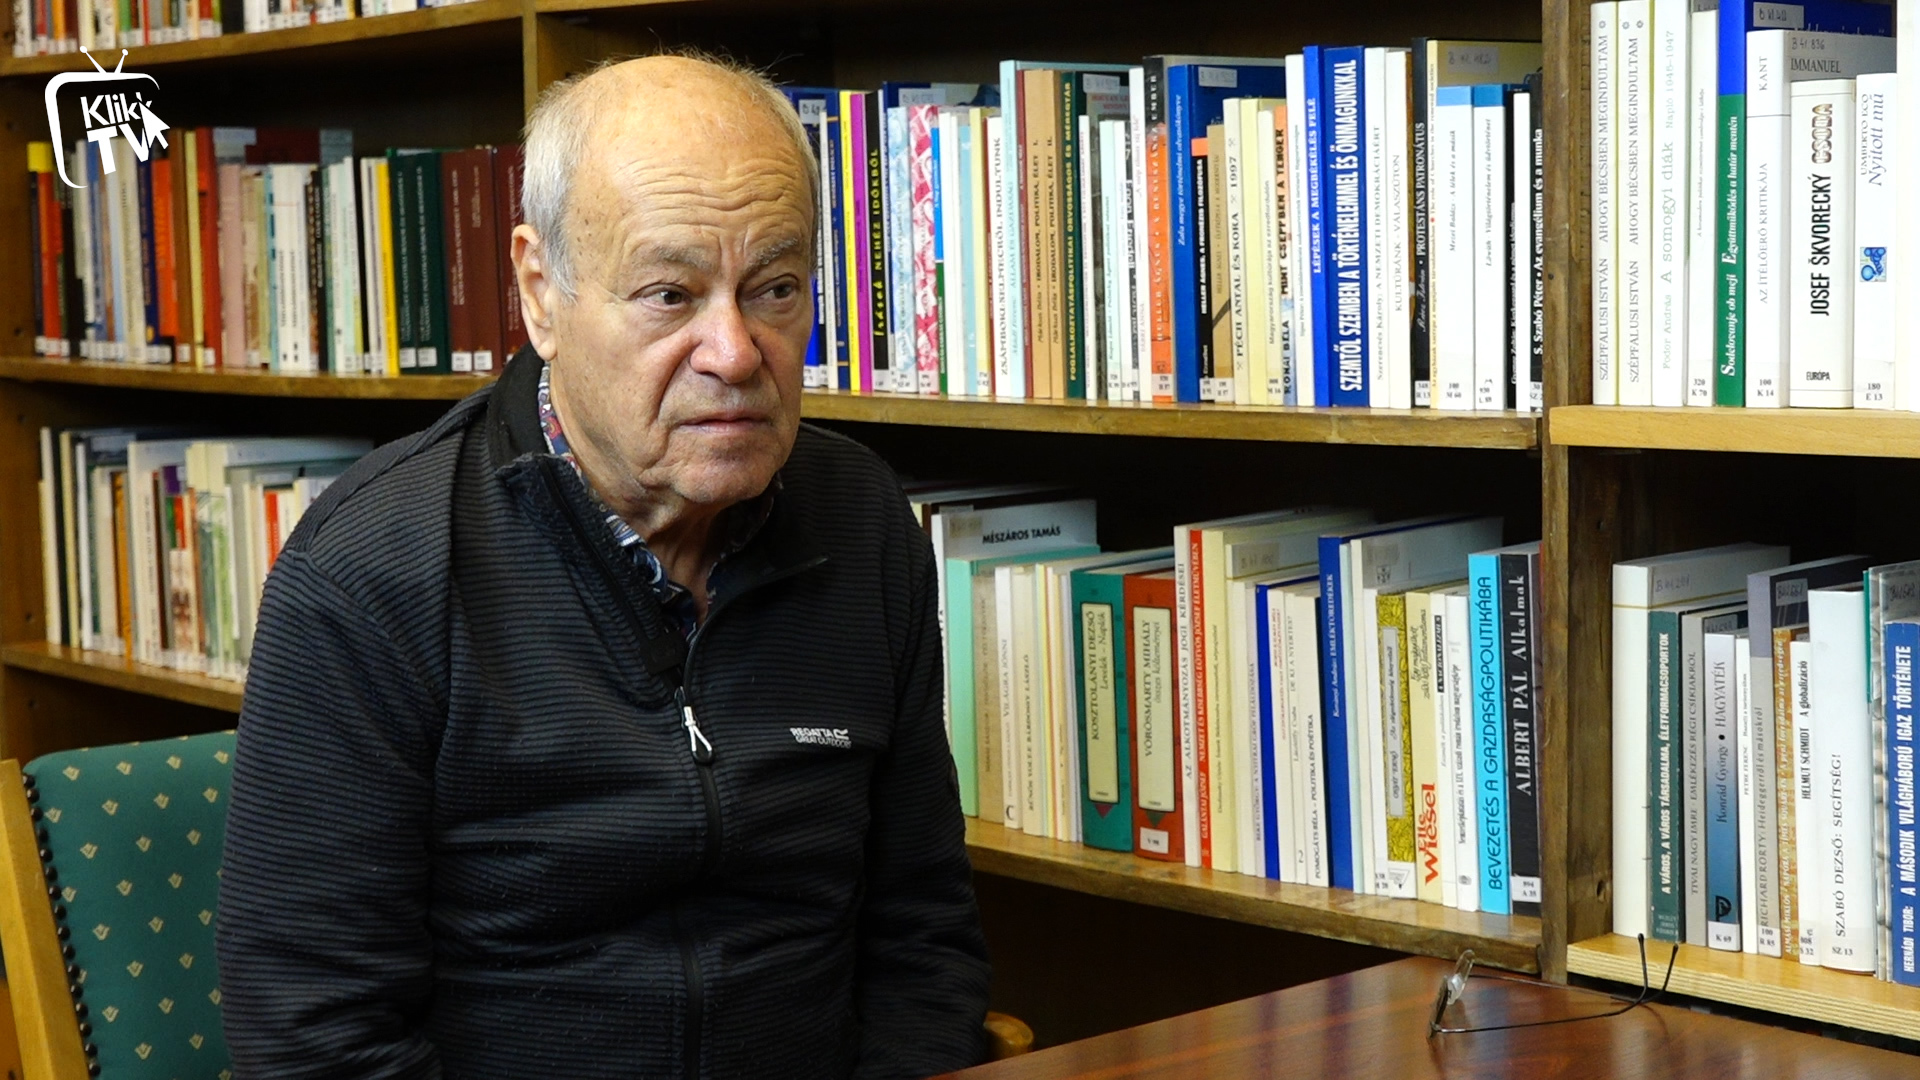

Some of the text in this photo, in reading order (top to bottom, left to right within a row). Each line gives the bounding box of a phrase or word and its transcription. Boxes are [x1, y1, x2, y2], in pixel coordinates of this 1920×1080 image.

[1759, 56, 1768, 91] KANT
[1791, 57, 1841, 73] IMMANUEL
[1063, 81, 1072, 142] MÉREGTÁR
[1597, 34, 1609, 244] AHOGY BÉCSBEN MEGINDULTAM
[1627, 35, 1639, 246] AHOGY BÉCSBEN MEGINDULTAM
[1726, 116, 1738, 151] mentén
[1861, 93, 1869, 176] UMBERTO ECO
[1064, 144, 1072, 158] ÉS
[1274, 128, 1285, 176] TENGER
[1532, 128, 1543, 166] munka
[1535, 167, 1543, 175] a
[1726, 152, 1738, 179] határ
[1868, 127, 1887, 187] Nyitott
[869, 148, 880, 215] IDŐKBŐL
[1277, 179, 1286, 189] A
[1306, 97, 1321, 274] LÉPÉSEK A MEGBÉKÉLÉS FELÉ
[1413, 121, 1426, 256] PROTESTÁNS PATRONÁTUS
[1532, 177, 1543, 191] és
[1729, 178, 1738, 188] a
[1808, 103, 1833, 317] JOSEF ŠKVORECKÝ CSODA
[1329, 58, 1363, 392] SZEMTŐL SZEMBEN A TÖRTÉNELEMMEL ÉS ÖNMAGUNKKAL
[1660, 141, 1677, 285] A somogyi diák
[1757, 163, 1769, 305] AZ ÍTÉLŐERŐ KRITIKÁJA
[871, 222, 882, 271] NEHÉZ
[1228, 155, 1244, 357] PÉCH ANTAL ÉS KORA 1997
[1534, 255, 1543, 271] Az
[1279, 266, 1289, 295] MINT
[1532, 280, 1543, 308] Péter
[1532, 310, 1543, 342] Szabó
[1533, 343, 1543, 355] S.
[1596, 258, 1609, 381] SZÉPFALUSI ISTVÁN
[1627, 260, 1640, 384] SZÉPFALUSI ISTVÁN
[1662, 294, 1672, 370] Fodor András
[1721, 273, 1739, 377] Sodelovanje ob meji
[1766, 389, 1774, 397] 14
[982, 525, 1062, 545] MÉSZÁROS TAMÁS
[1086, 610, 1101, 742] KOSZTOLÁNYI DEZSŐ
[1141, 619, 1153, 757] VÖRÖSMARTY MIHÁLY
[1176, 562, 1192, 780] AZ ALKOTMÁNYOZÁS JOGI KÉRDÉSEI
[1509, 575, 1532, 797] ALBERT PÁL Alkalmak
[1797, 660, 1812, 709] globalizáció
[790, 727, 834, 738] REGATTA
[1475, 576, 1503, 890] BEVEZETÉS A GAZDASÁGPOLITIKÁBA
[1687, 715, 1698, 742] RÉGI
[1711, 660, 1731, 823] Konrád György HAGYATÉK
[1658, 632, 1672, 895] A VÁROS, A VÁROS TÁRSADALMA, ÉLETFORMACSOPORTOK
[1688, 743, 1698, 801] EMLÉKEZÉS
[1799, 726, 1811, 800] HELMUT SCHMIDT
[1421, 782, 1439, 884] Wiesel
[1690, 808, 1698, 834] IMRE
[1892, 644, 1917, 973] HERNÁDI TIBOR: A MÁSODIK VILÁGHÁBORÚ IGAZ TÖRTÉNETE
[1690, 835, 1698, 865] NAGY
[1829, 752, 1847, 937] SZABÓ DEZSŐ: SEGÍTSÉG!
